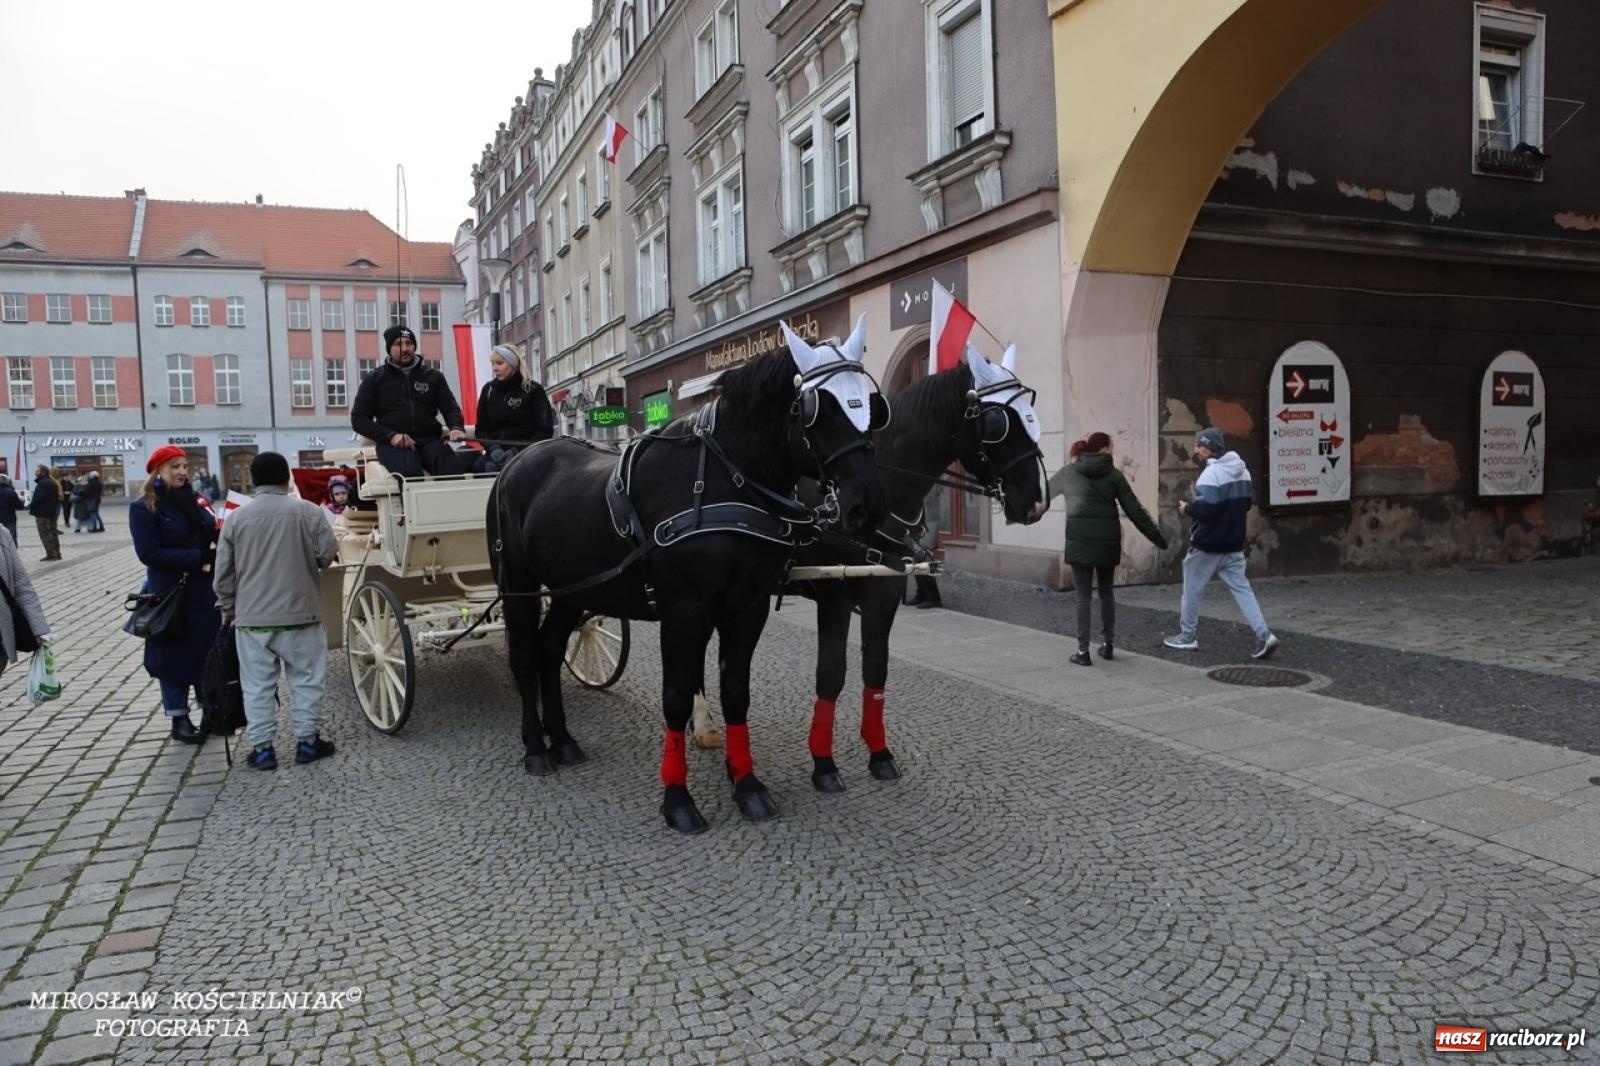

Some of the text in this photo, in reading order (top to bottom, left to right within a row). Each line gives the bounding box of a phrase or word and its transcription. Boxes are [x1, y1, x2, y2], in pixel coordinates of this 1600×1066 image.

[747, 331, 776, 357] Lodów
[42, 436, 106, 447] JUBILER
[168, 437, 200, 445] BOLKO
